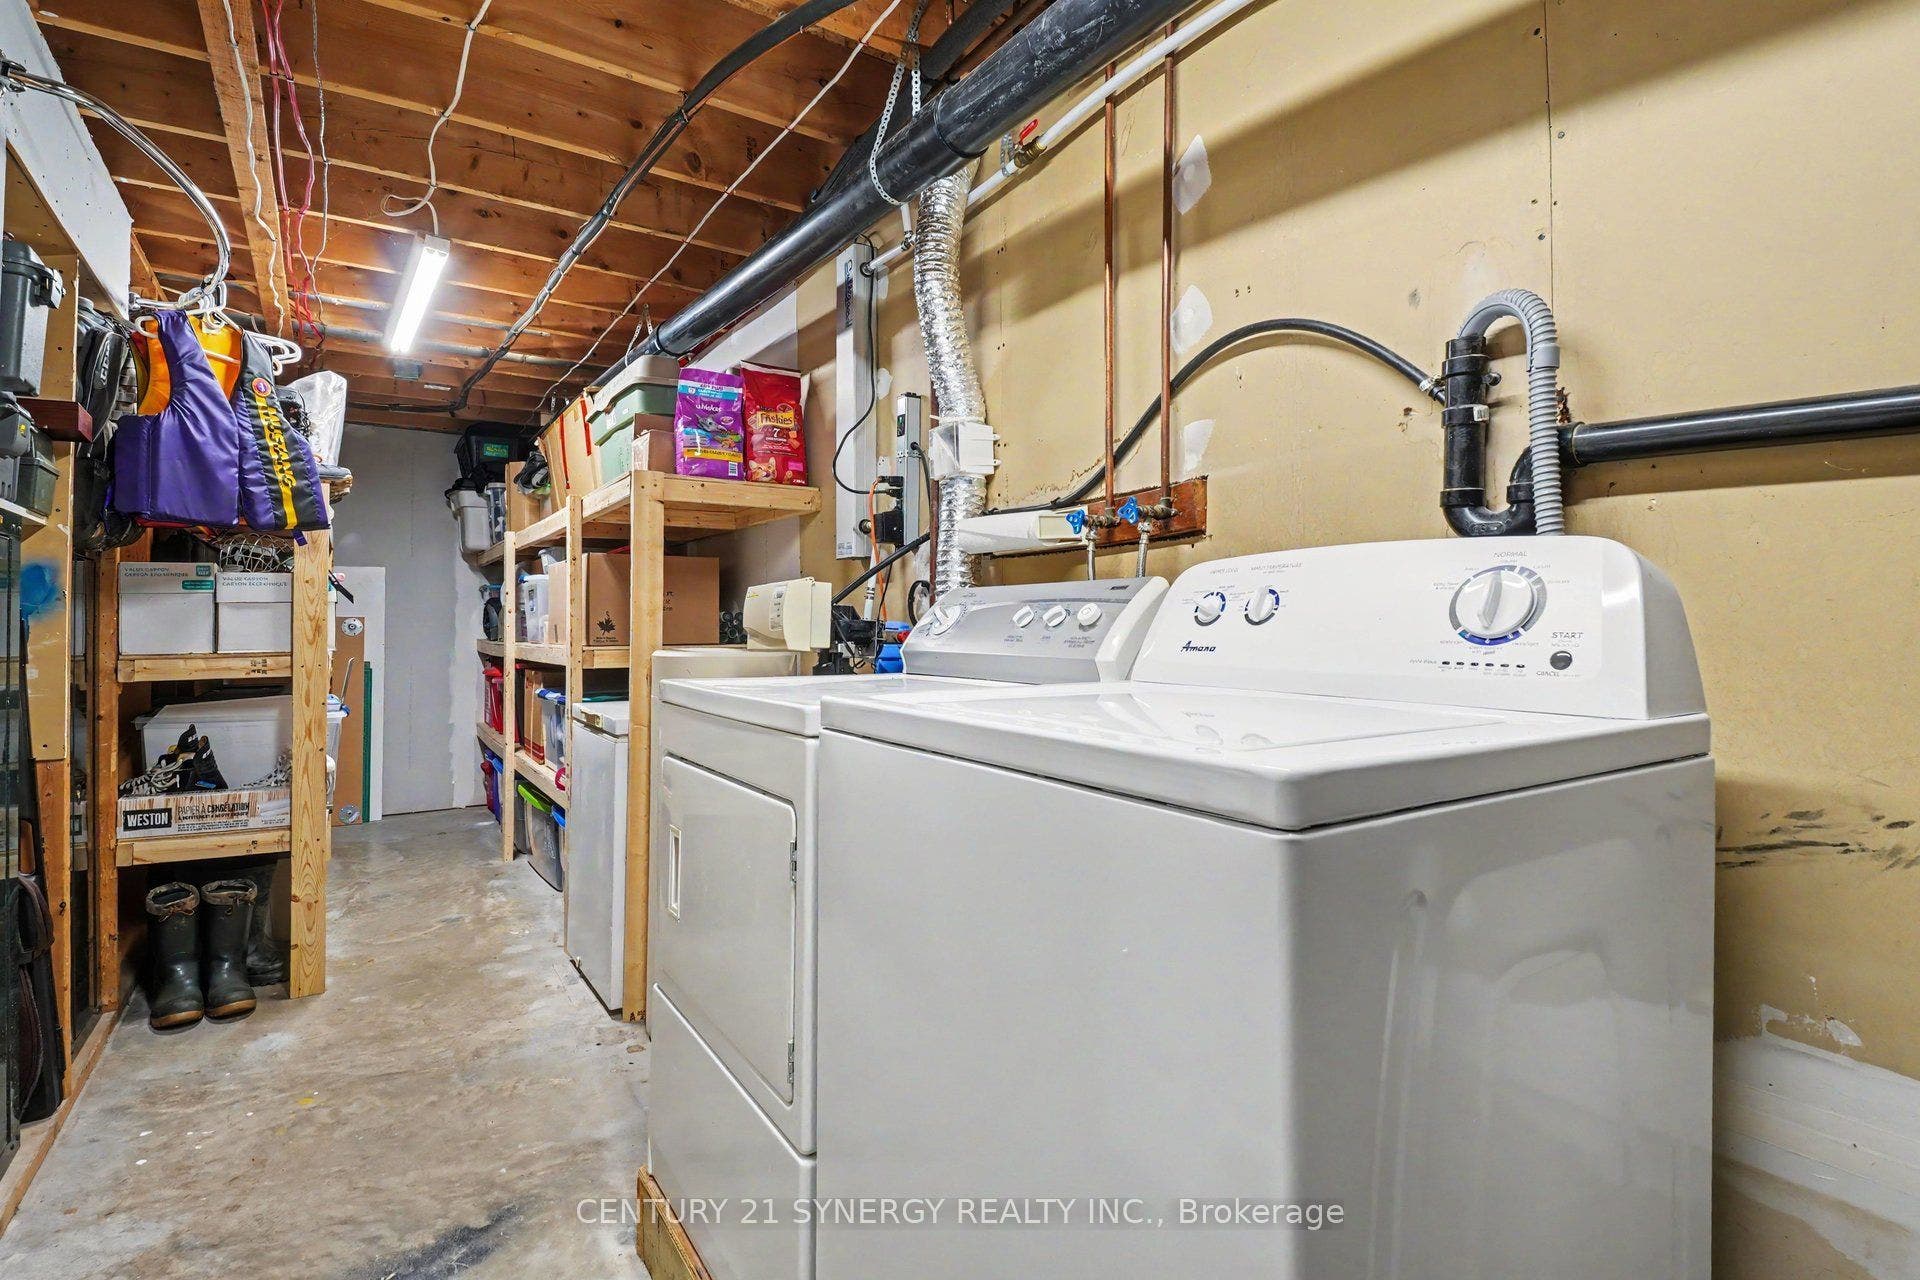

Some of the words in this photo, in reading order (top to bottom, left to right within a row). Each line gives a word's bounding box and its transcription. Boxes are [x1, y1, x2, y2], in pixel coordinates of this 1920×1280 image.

[760, 413, 792, 425] Friskies
[773, 428, 780, 437] 7
[259, 405, 297, 488] MUSTANG
[1181, 640, 1217, 652] Amana
[127, 812, 169, 828] WESTON
